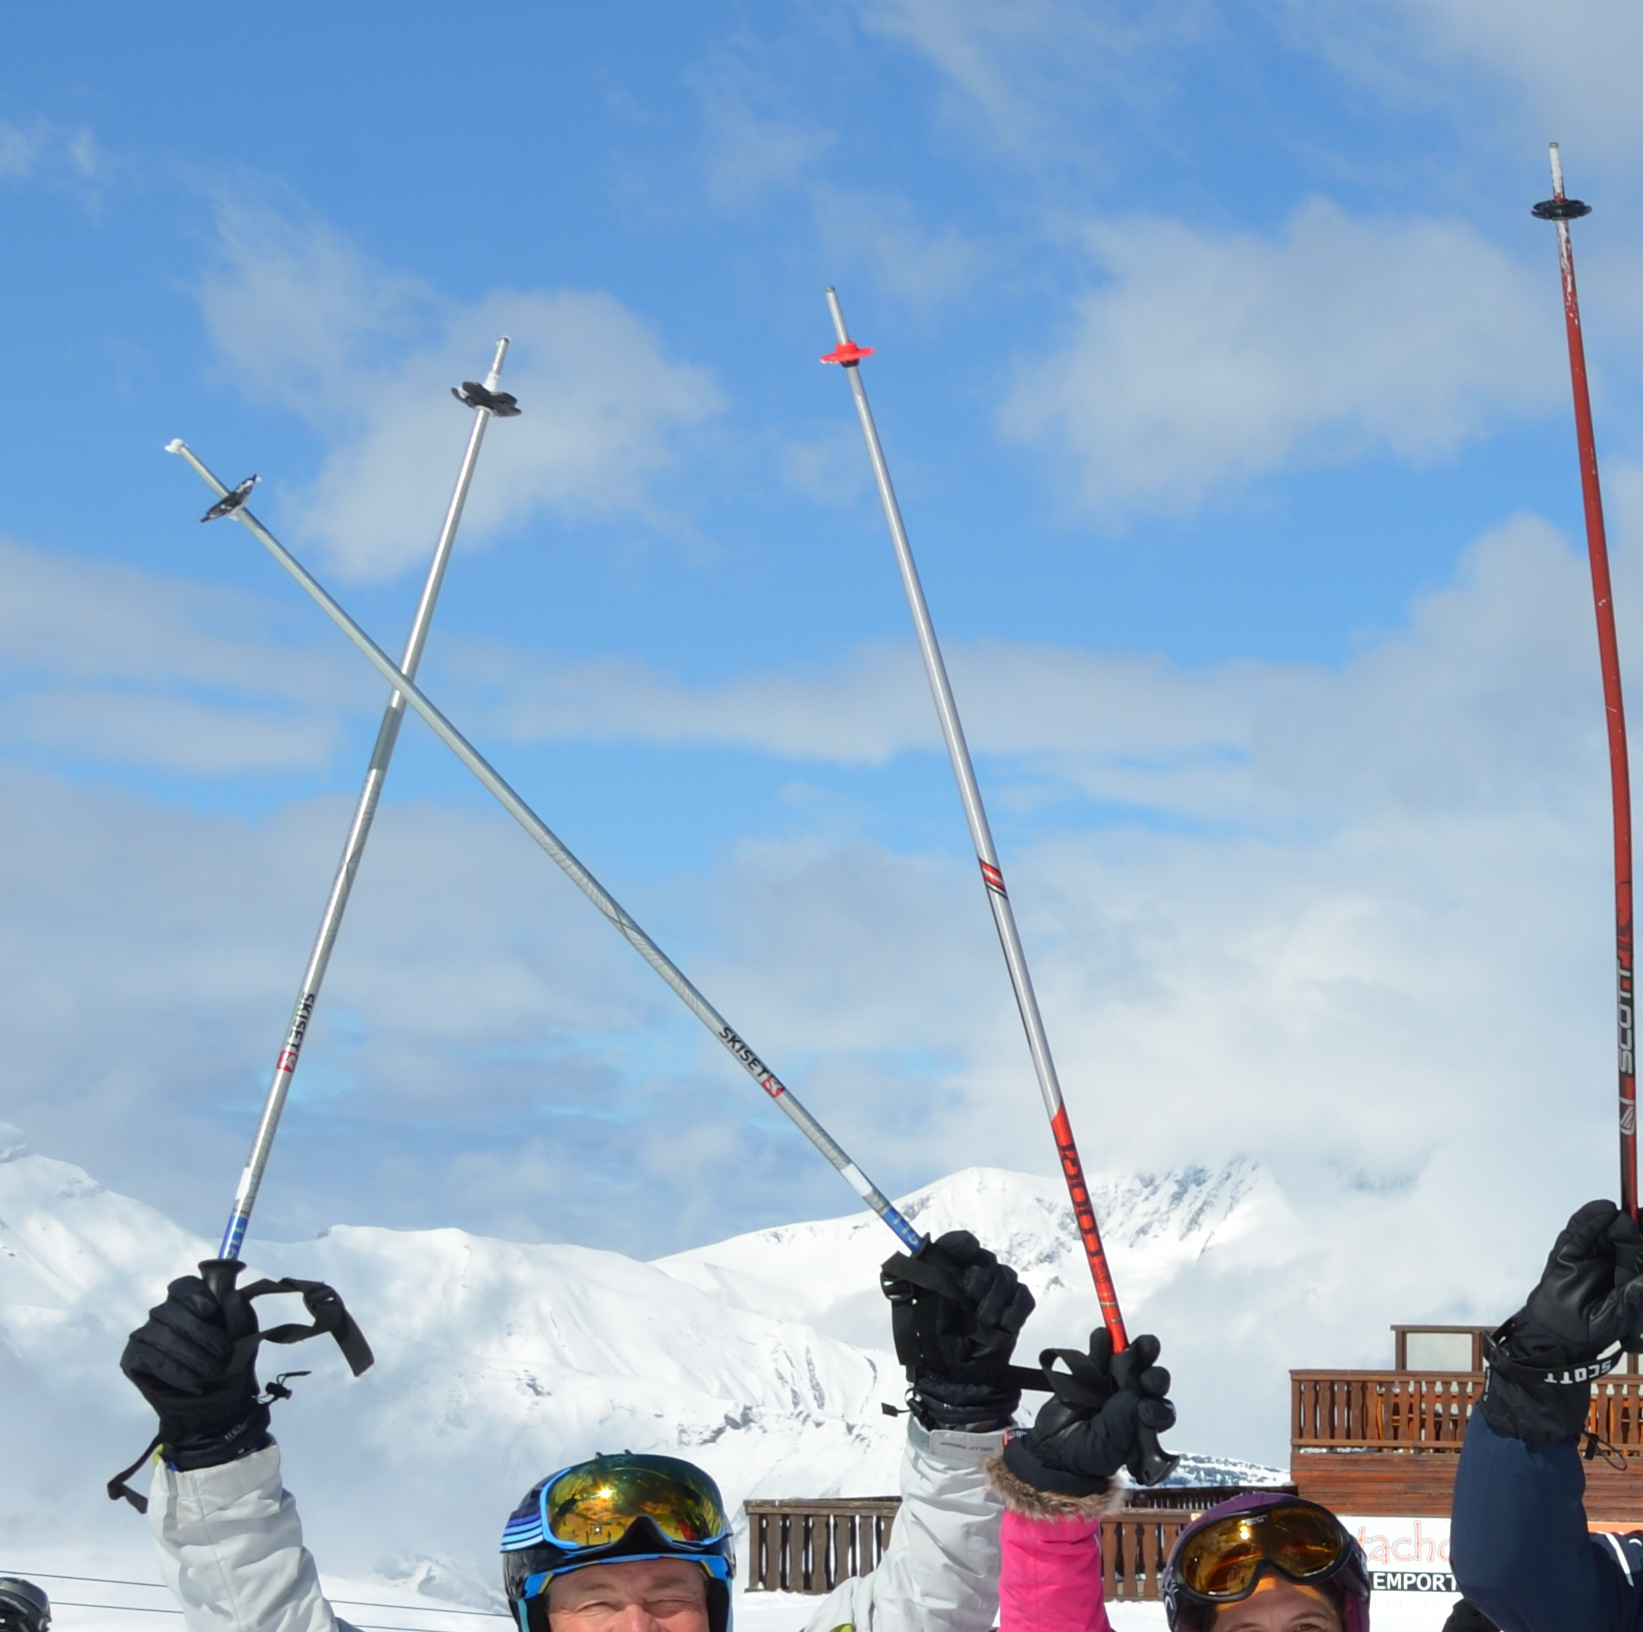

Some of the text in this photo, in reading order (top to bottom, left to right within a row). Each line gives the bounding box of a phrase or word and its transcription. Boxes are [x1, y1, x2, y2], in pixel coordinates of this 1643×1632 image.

[291, 993, 315, 1052] SKISET
[1616, 958, 1633, 1074] SCOTT
[719, 1027, 769, 1077] SKISET
[1544, 1360, 1612, 1385] SCOTT
[1356, 1521, 1451, 1564] tach
[1373, 1572, 1457, 1591] EMPORT
